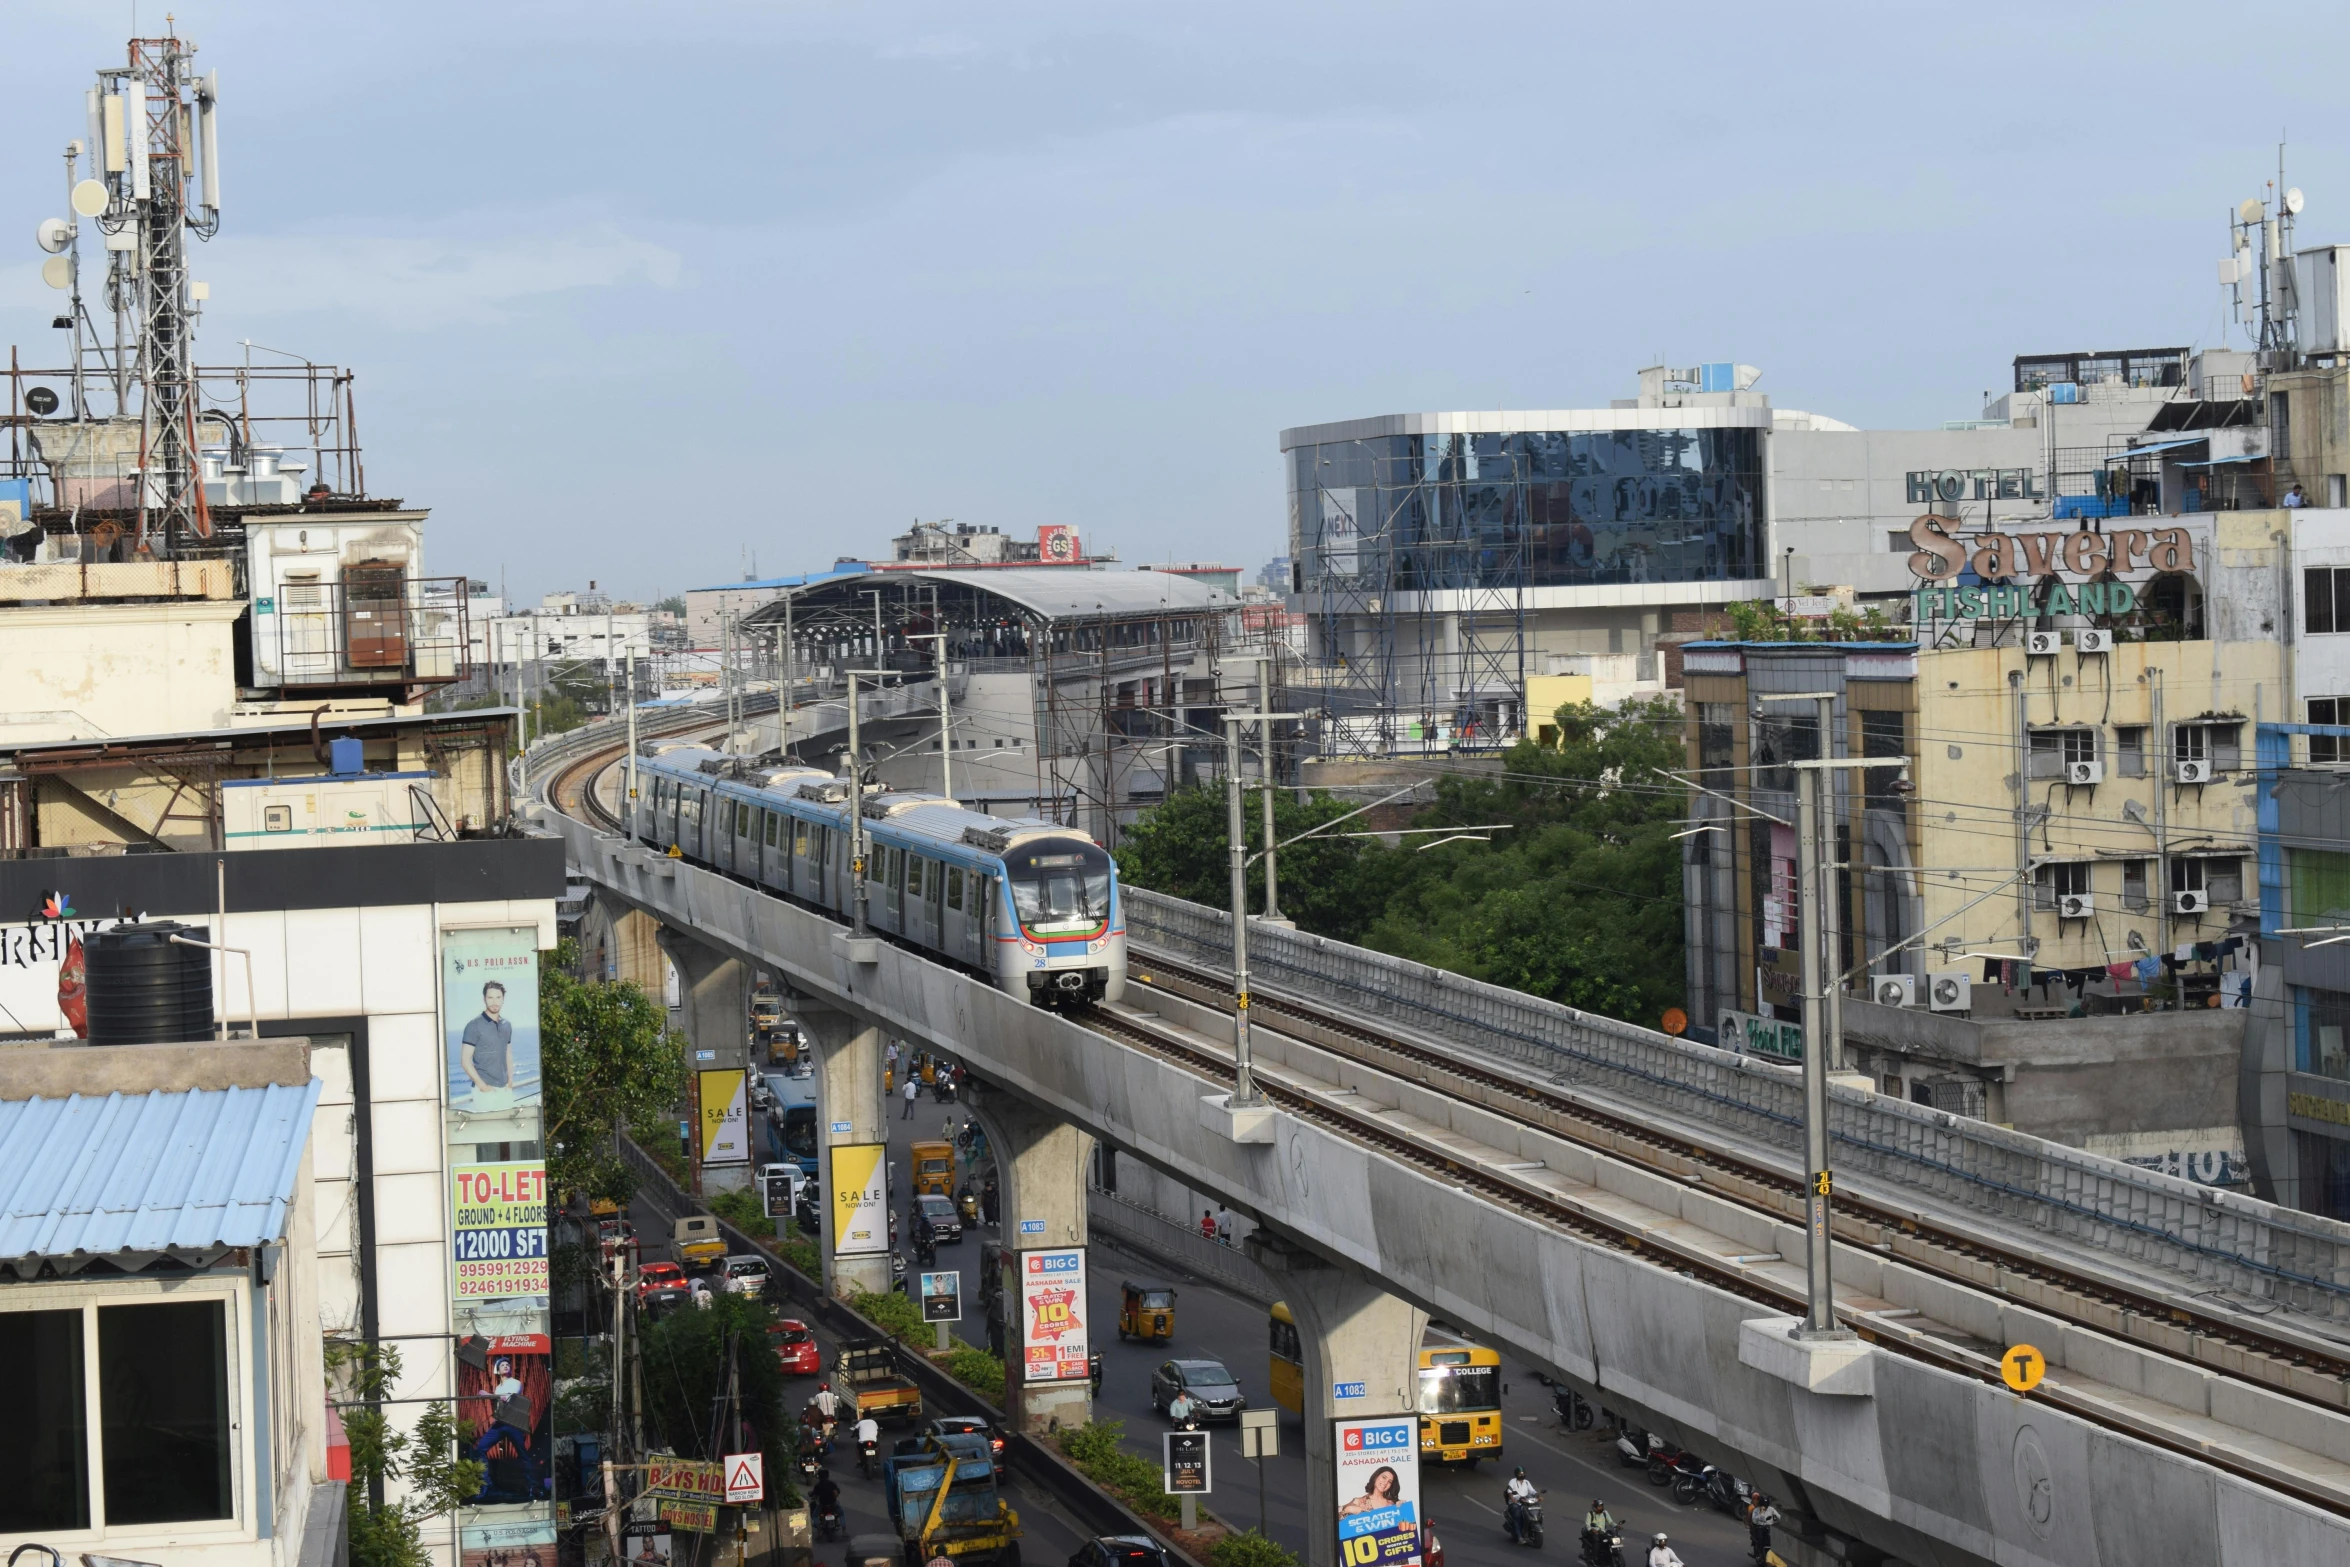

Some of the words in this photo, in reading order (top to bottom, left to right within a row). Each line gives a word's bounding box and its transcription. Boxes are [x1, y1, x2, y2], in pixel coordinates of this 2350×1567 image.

[1907, 468, 2044, 503] HOTEL
[1053, 540, 1068, 552] GS
[1908, 514, 2196, 580] Savera
[1918, 582, 2135, 620] FISHLAND
[485, 958, 504, 966] POLO
[1034, 959, 1046, 968] 28
[708, 1108, 742, 1118] SALE
[1820, 1172, 1828, 1182] 21
[458, 1170, 546, 1204] TO-LET
[1819, 1184, 1829, 1194] 43
[840, 1190, 880, 1202] SALE
[458, 1208, 495, 1225] GROUND
[505, 1207, 511, 1223] 4
[513, 1205, 547, 1223] FLOORS
[1028, 1223, 1044, 1231] 1083
[457, 1230, 510, 1259] 12000
[516, 1229, 547, 1256] SFT
[460, 1261, 548, 1277] 9959912929
[1045, 1259, 1066, 1269] BIG
[1068, 1258, 1076, 1267] C
[460, 1278, 549, 1294] 9246191934
[1034, 1293, 1066, 1301] SCRATCH
[1038, 1303, 1069, 1323] 10
[1040, 1321, 1069, 1329] CRORES
[1456, 1367, 1492, 1375] COLLEGE
[2013, 1355, 2032, 1382] T
[1336, 1386, 1342, 1396] A
[1345, 1384, 1364, 1395] 1082
[1365, 1432, 1392, 1445] BIG
[1395, 1430, 1406, 1442] C
[1342, 1457, 1388, 1466] AASHADAM
[1390, 1455, 1411, 1463] SALE
[649, 1468, 694, 1492] BOYS
[1348, 1509, 1400, 1526] SCRATCH
[1356, 1525, 1364, 1533] &
[1365, 1518, 1395, 1531] WIN
[1378, 1532, 1415, 1546] CRORES
[1343, 1535, 1379, 1567] 10
[1385, 1544, 1414, 1557] GIFTS
